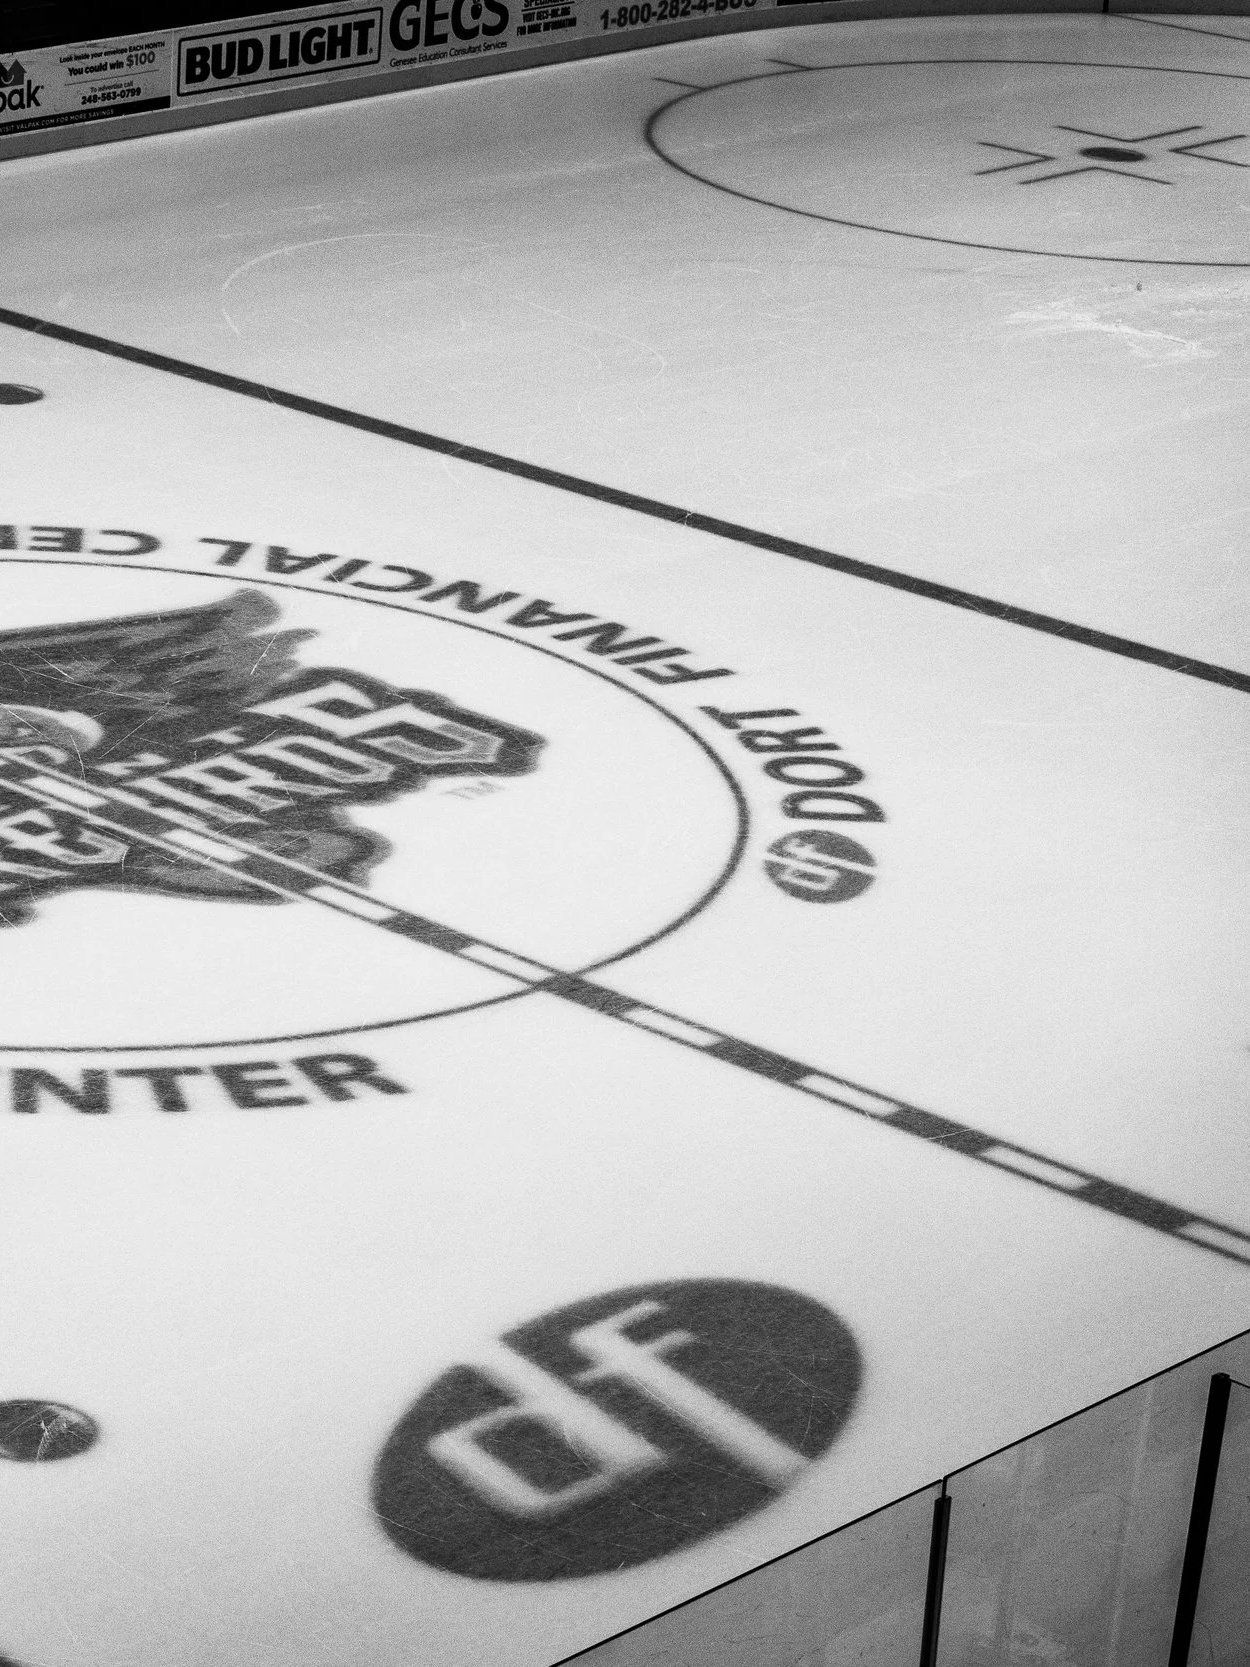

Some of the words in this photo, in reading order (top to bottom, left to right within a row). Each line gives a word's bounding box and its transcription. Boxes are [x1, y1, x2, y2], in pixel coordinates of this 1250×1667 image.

[389, 0, 509, 51] GECS
[68, 67, 83, 76] You
[85, 62, 108, 74] could
[109, 60, 124, 70] win
[126, 51, 155, 68] $100
[74, 53, 90, 61] inside
[91, 51, 103, 59] your
[104, 48, 128, 56] envelope
[129, 44, 144, 52] EACH
[145, 41, 165, 50] MONTH
[185, 38, 264, 84] BUD
[269, 19, 375, 71] LIGHT
[390, 57, 417, 67] Genesee
[418, 50, 448, 63] Education
[449, 44, 482, 57] Consultant
[483, 40, 507, 52] Services
[81, 87, 141, 105] 248-563-0799
[0, 125, 14, 133] VISIT
[70, 113, 87, 121] MORE
[88, 108, 115, 119] SAVINGS
[199, 536, 736, 687] FINANCIAL
[698, 705, 889, 824] DORT
